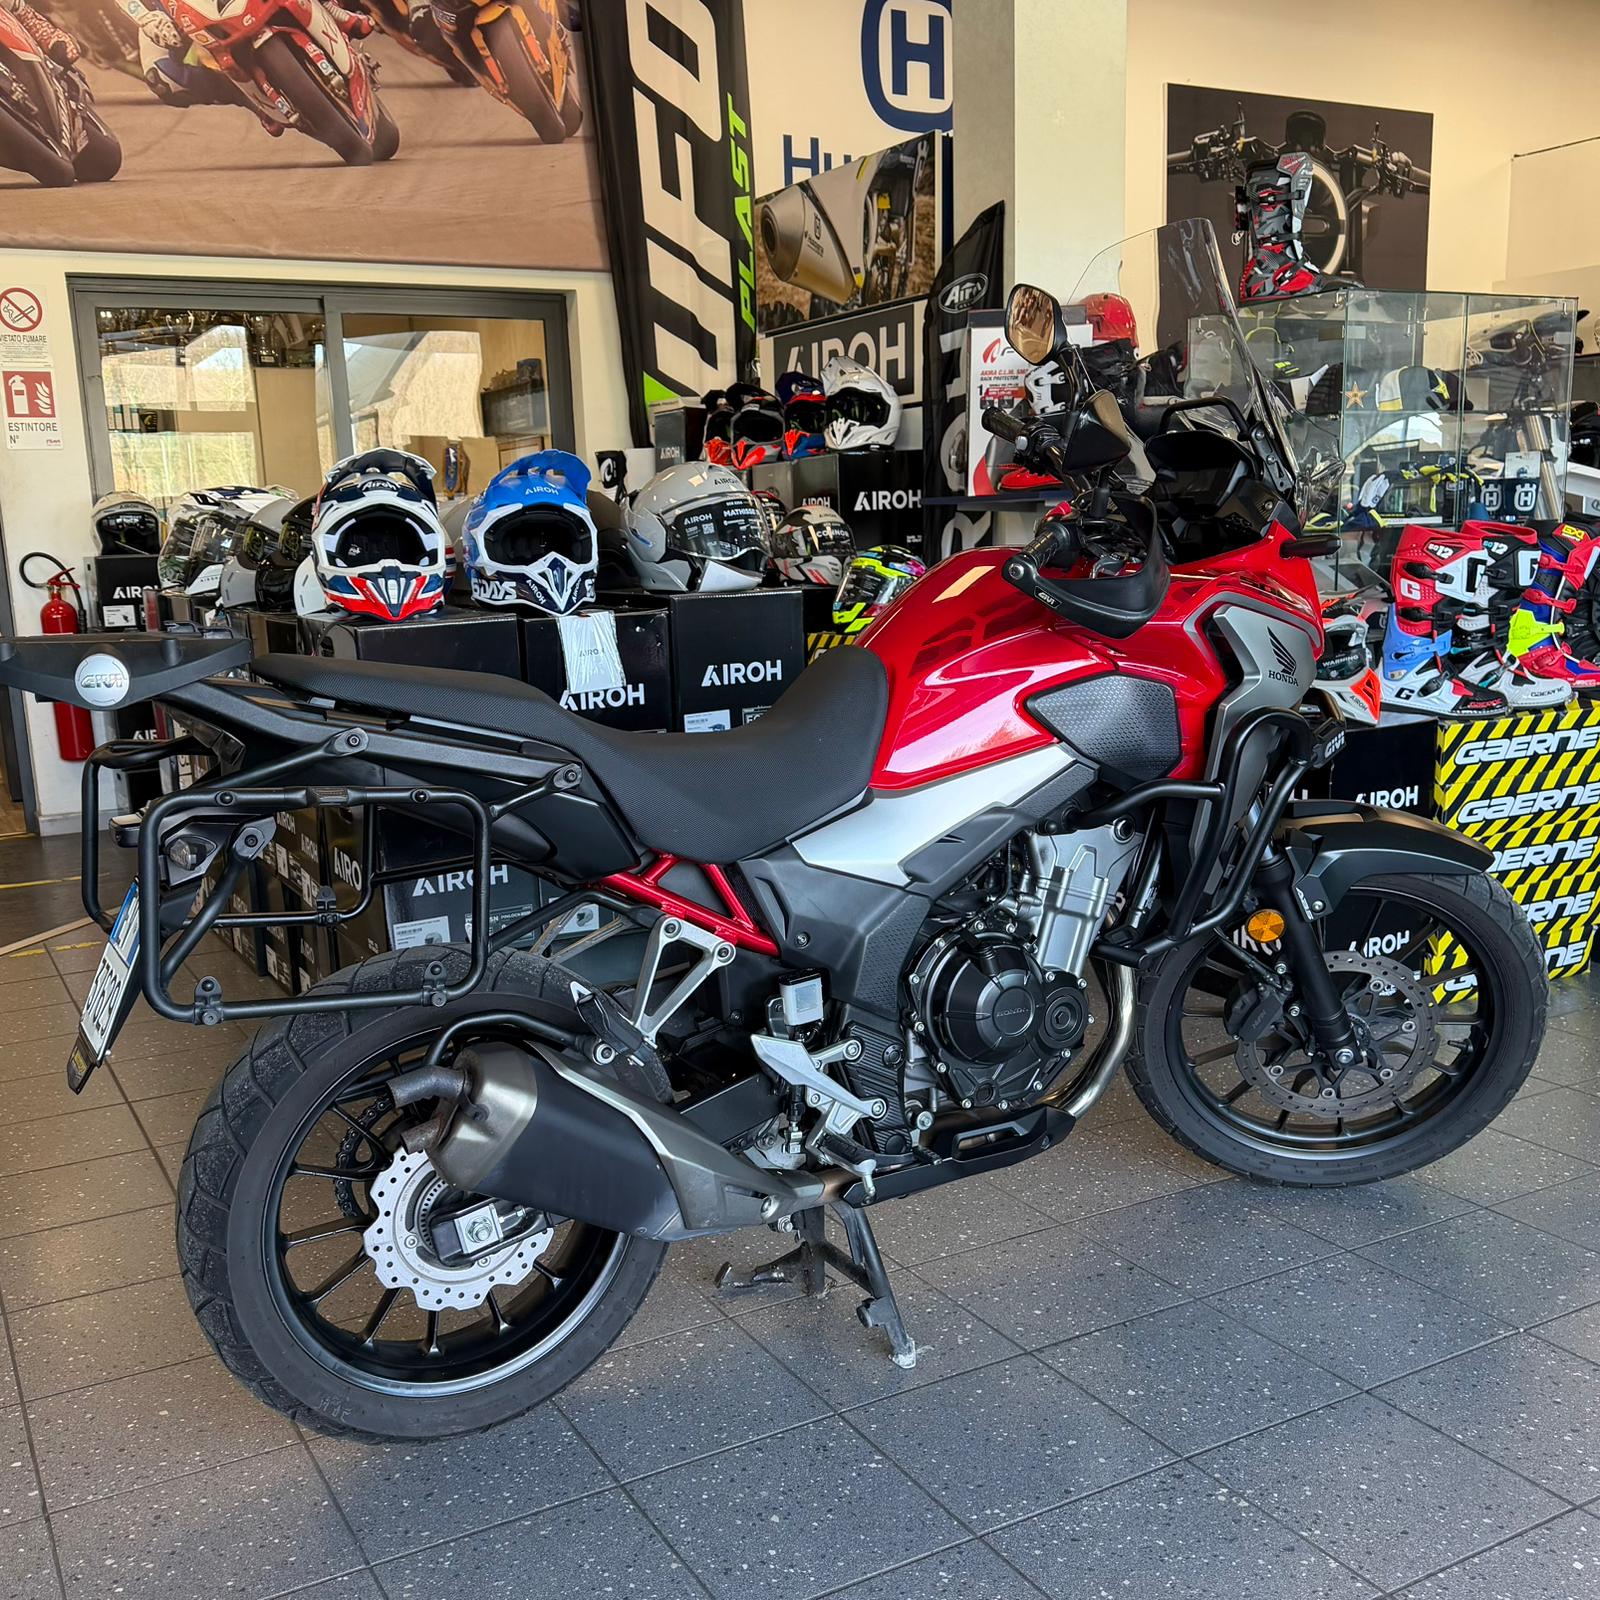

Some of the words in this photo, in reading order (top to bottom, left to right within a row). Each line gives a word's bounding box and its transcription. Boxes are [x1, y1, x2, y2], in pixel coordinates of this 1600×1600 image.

[727, 92, 756, 333] PLAST
[22, 335, 47, 343] FUMARE
[8, 422, 58, 432] ESTINTORE
[659, 448, 681, 459] AIROH
[525, 486, 559, 496] AIROH
[853, 489, 922, 512] AIROH
[683, 513, 713, 526] AIROH
[112, 585, 159, 600] AIR
[525, 579, 547, 605] AIROH
[1322, 655, 1360, 667] WARNING
[701, 659, 783, 688] AIROH
[1268, 670, 1299, 687] HONDA
[559, 683, 646, 711] AIROH
[1350, 694, 1368, 712] AIROH
[1324, 730, 1346, 759] GIVI
[1486, 835, 1599, 873] ERNE
[334, 847, 363, 892] AIRO
